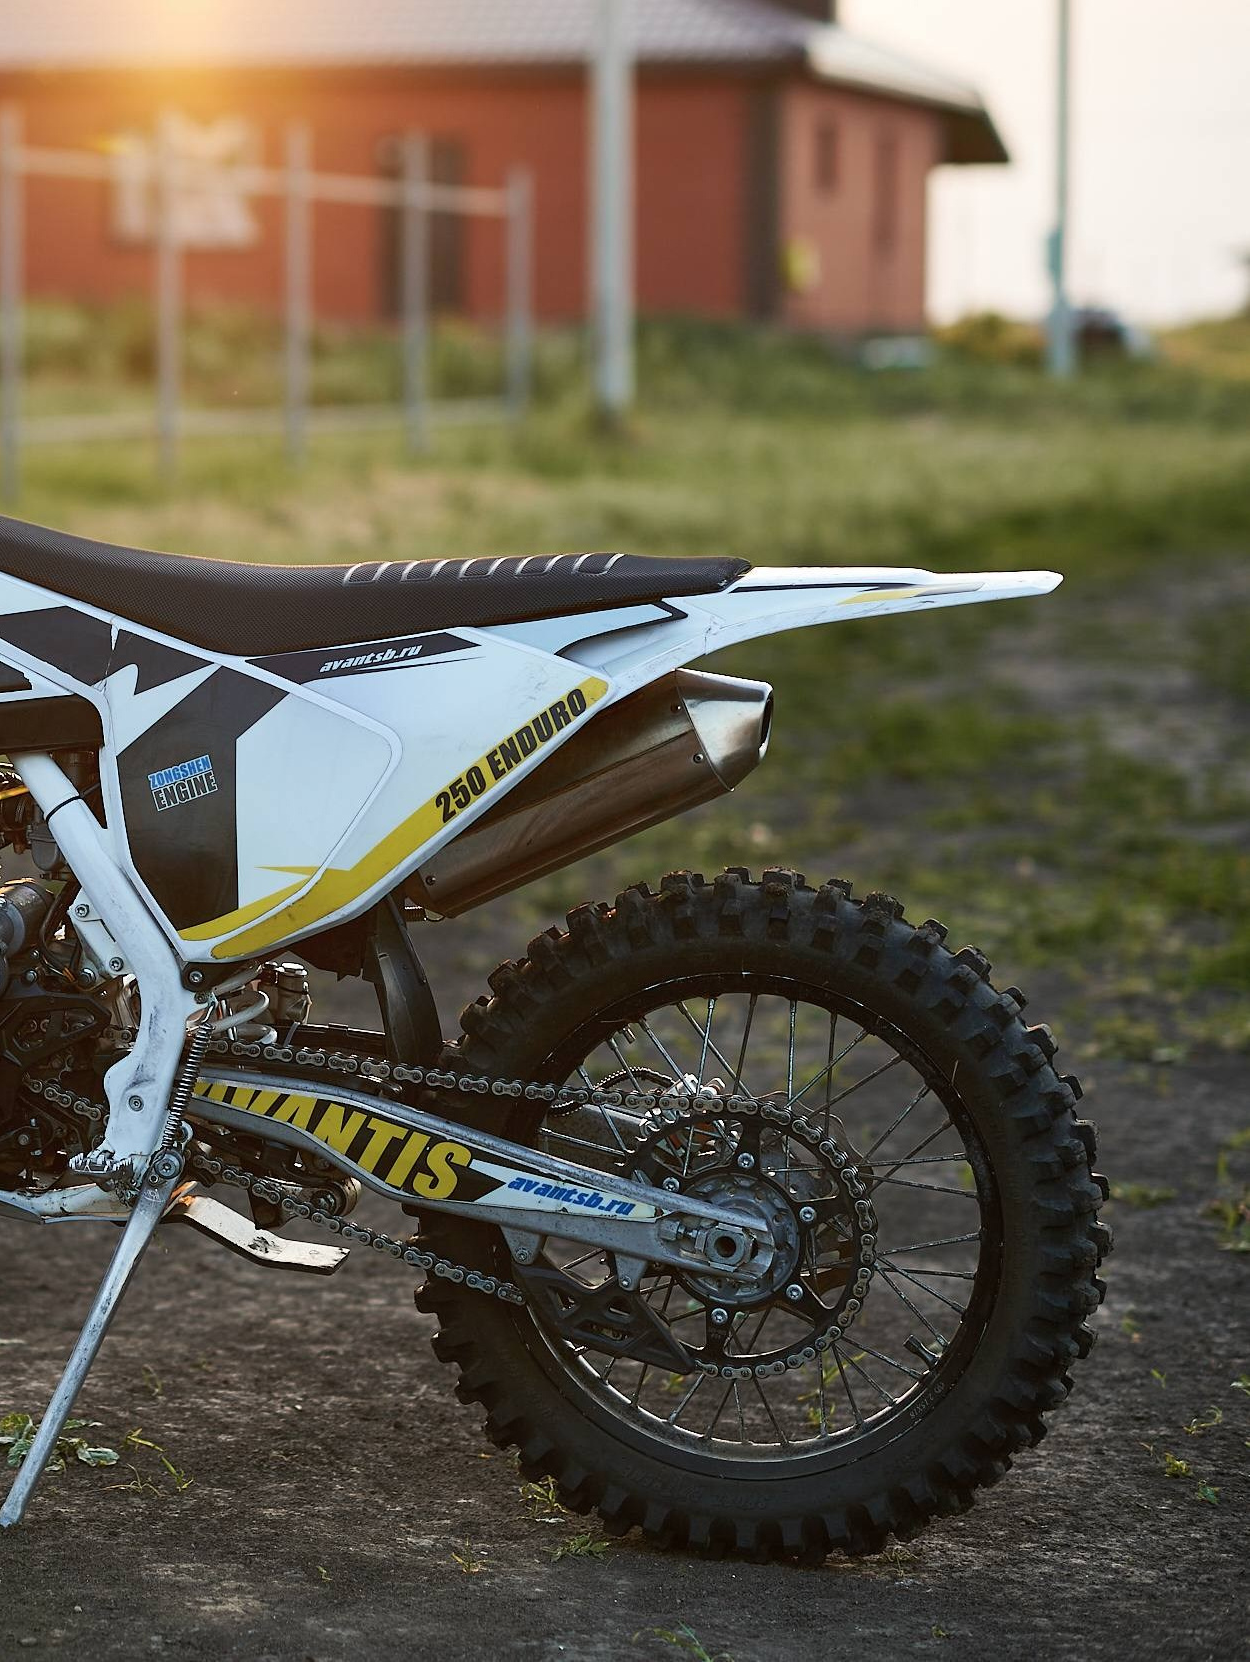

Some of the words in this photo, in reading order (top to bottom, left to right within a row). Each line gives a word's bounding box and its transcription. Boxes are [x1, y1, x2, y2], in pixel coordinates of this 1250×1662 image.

[319, 645, 423, 673] avantsb.ru
[148, 755, 212, 790] ZONGSHEN
[435, 766, 487, 823] 250
[485, 688, 587, 780] ENDURO
[152, 770, 218, 811] ENGINE
[507, 1177, 636, 1215] avantsb.ru
